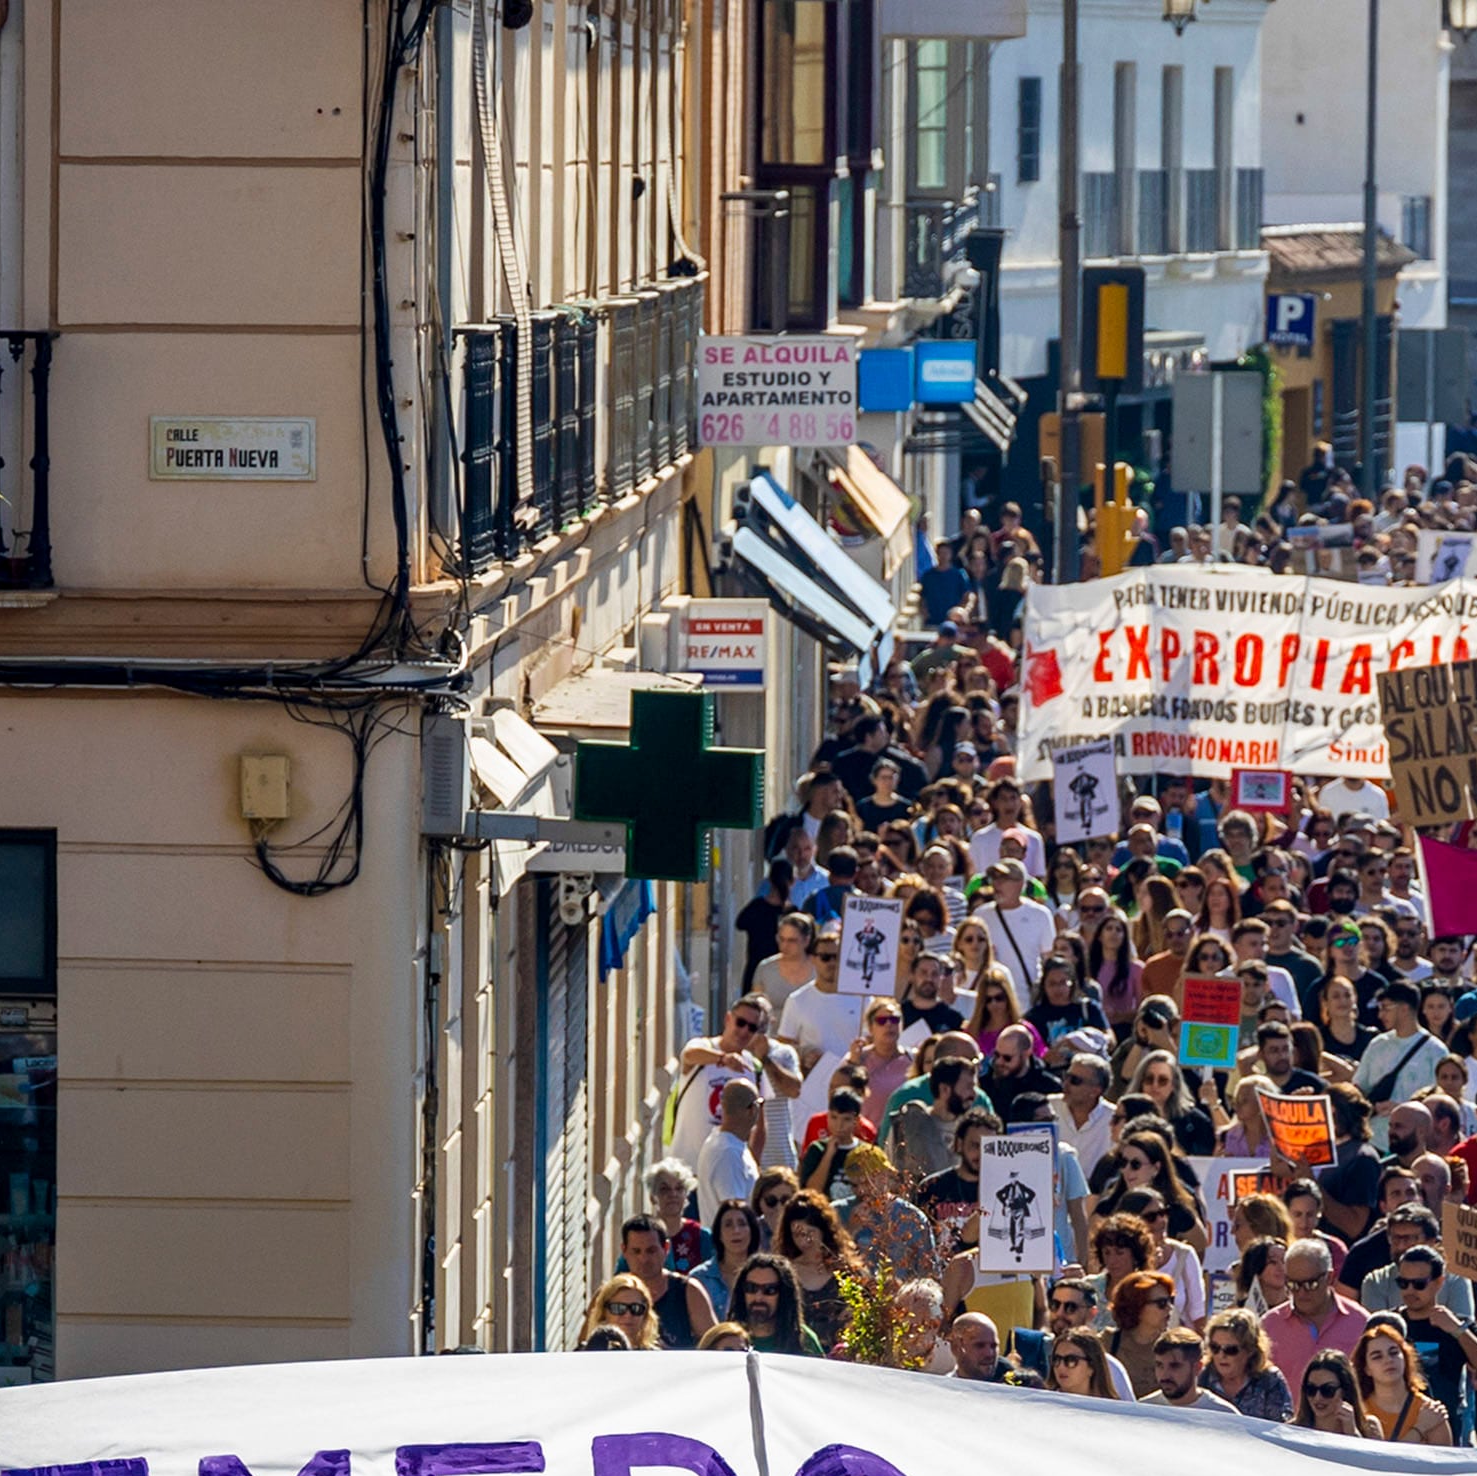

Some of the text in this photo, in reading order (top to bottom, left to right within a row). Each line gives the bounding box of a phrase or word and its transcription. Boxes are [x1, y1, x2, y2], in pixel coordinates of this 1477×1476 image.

[1277, 297, 1305, 331] P
[705, 346, 850, 364] SE ALQUILA
[723, 371, 831, 386] ESTUDIO Y
[702, 391, 852, 406] APARTAMENTO
[166, 429, 199, 442] CALLE
[702, 413, 744, 442] 626
[789, 412, 817, 440] 88
[826, 412, 854, 440] 56
[166, 448, 279, 468] PUERTA NUEVA
[1159, 585, 1210, 610] TENER
[695, 622, 751, 631] EN VENTA
[687, 645, 756, 659] RE/MAX
[1321, 706, 1334, 726] Y
[1328, 739, 1384, 765] Sind
[1408, 765, 1461, 817] NO
[997, 1139, 1050, 1159] BOQUERONES
